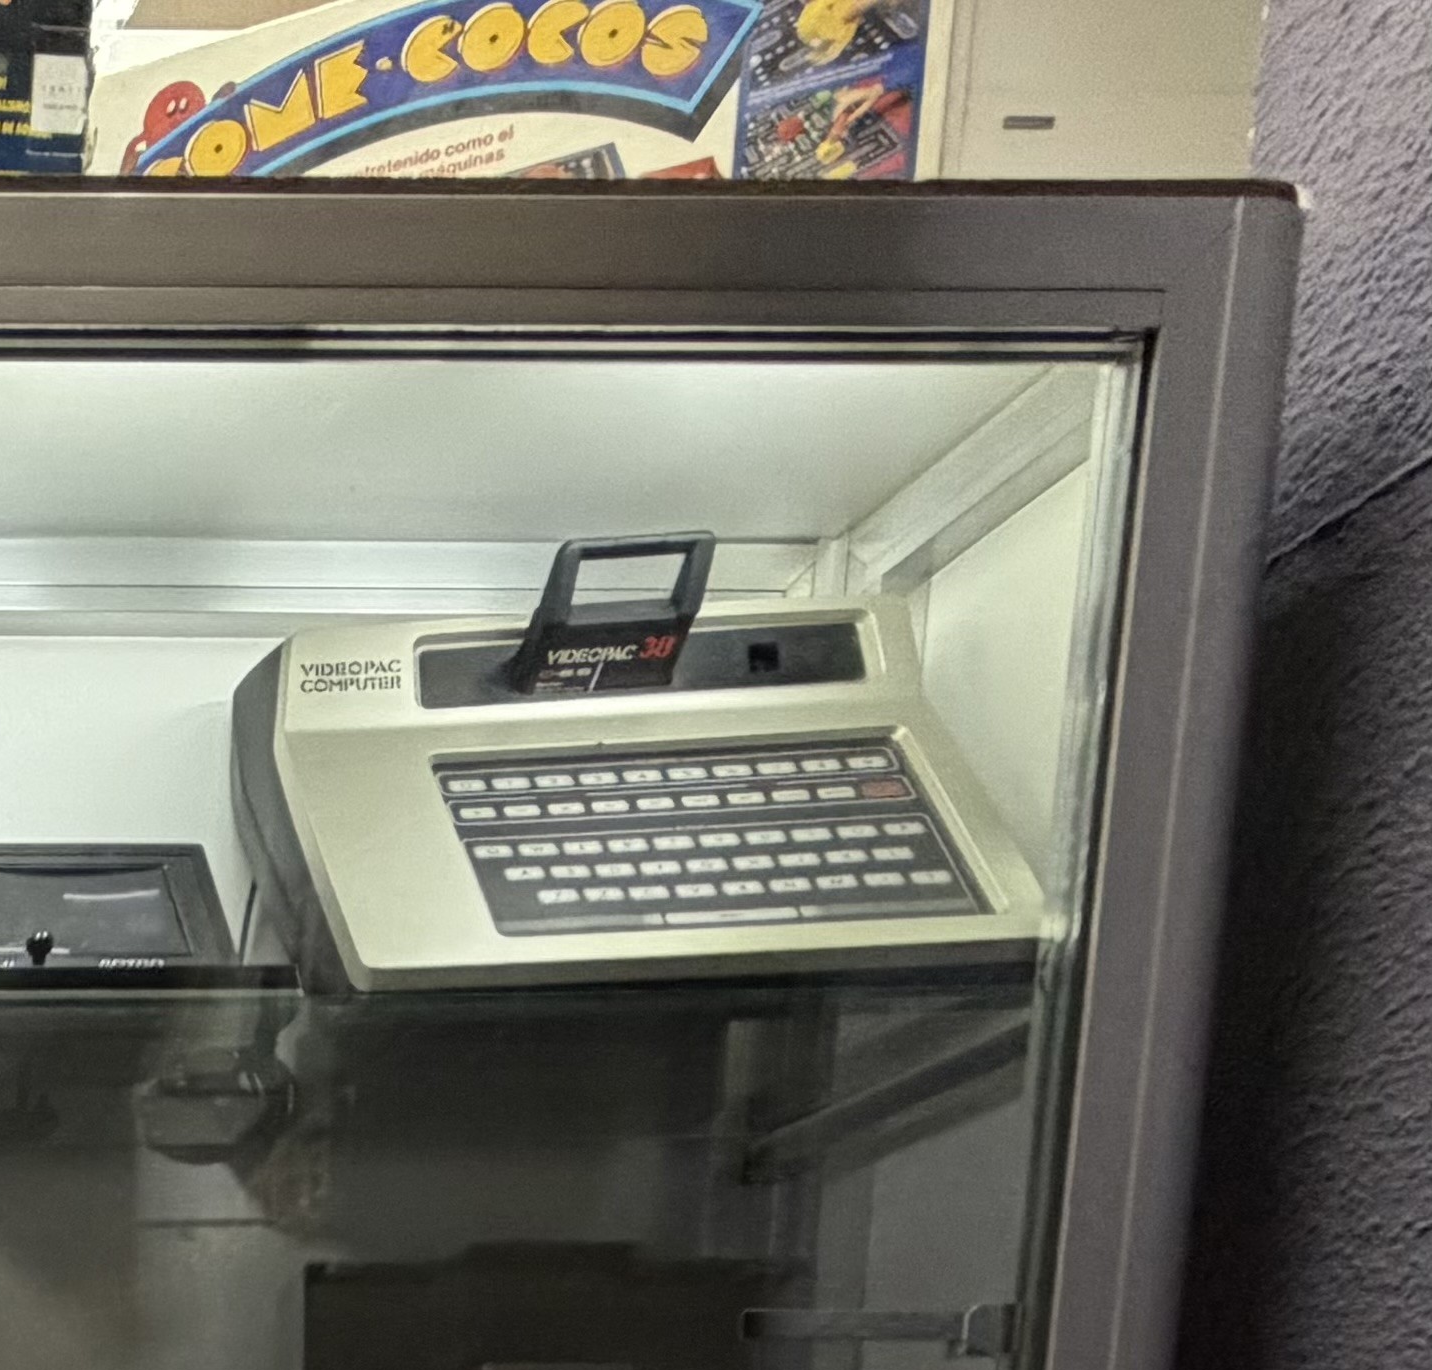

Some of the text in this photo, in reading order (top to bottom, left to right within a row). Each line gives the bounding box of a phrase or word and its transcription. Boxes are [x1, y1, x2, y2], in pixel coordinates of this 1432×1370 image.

[445, 133, 494, 160] como
[497, 124, 515, 145] el
[546, 645, 638, 666] VIDEOPAC
[300, 659, 403, 679] VIDEOPAC
[300, 673, 403, 694] COMPUTER
